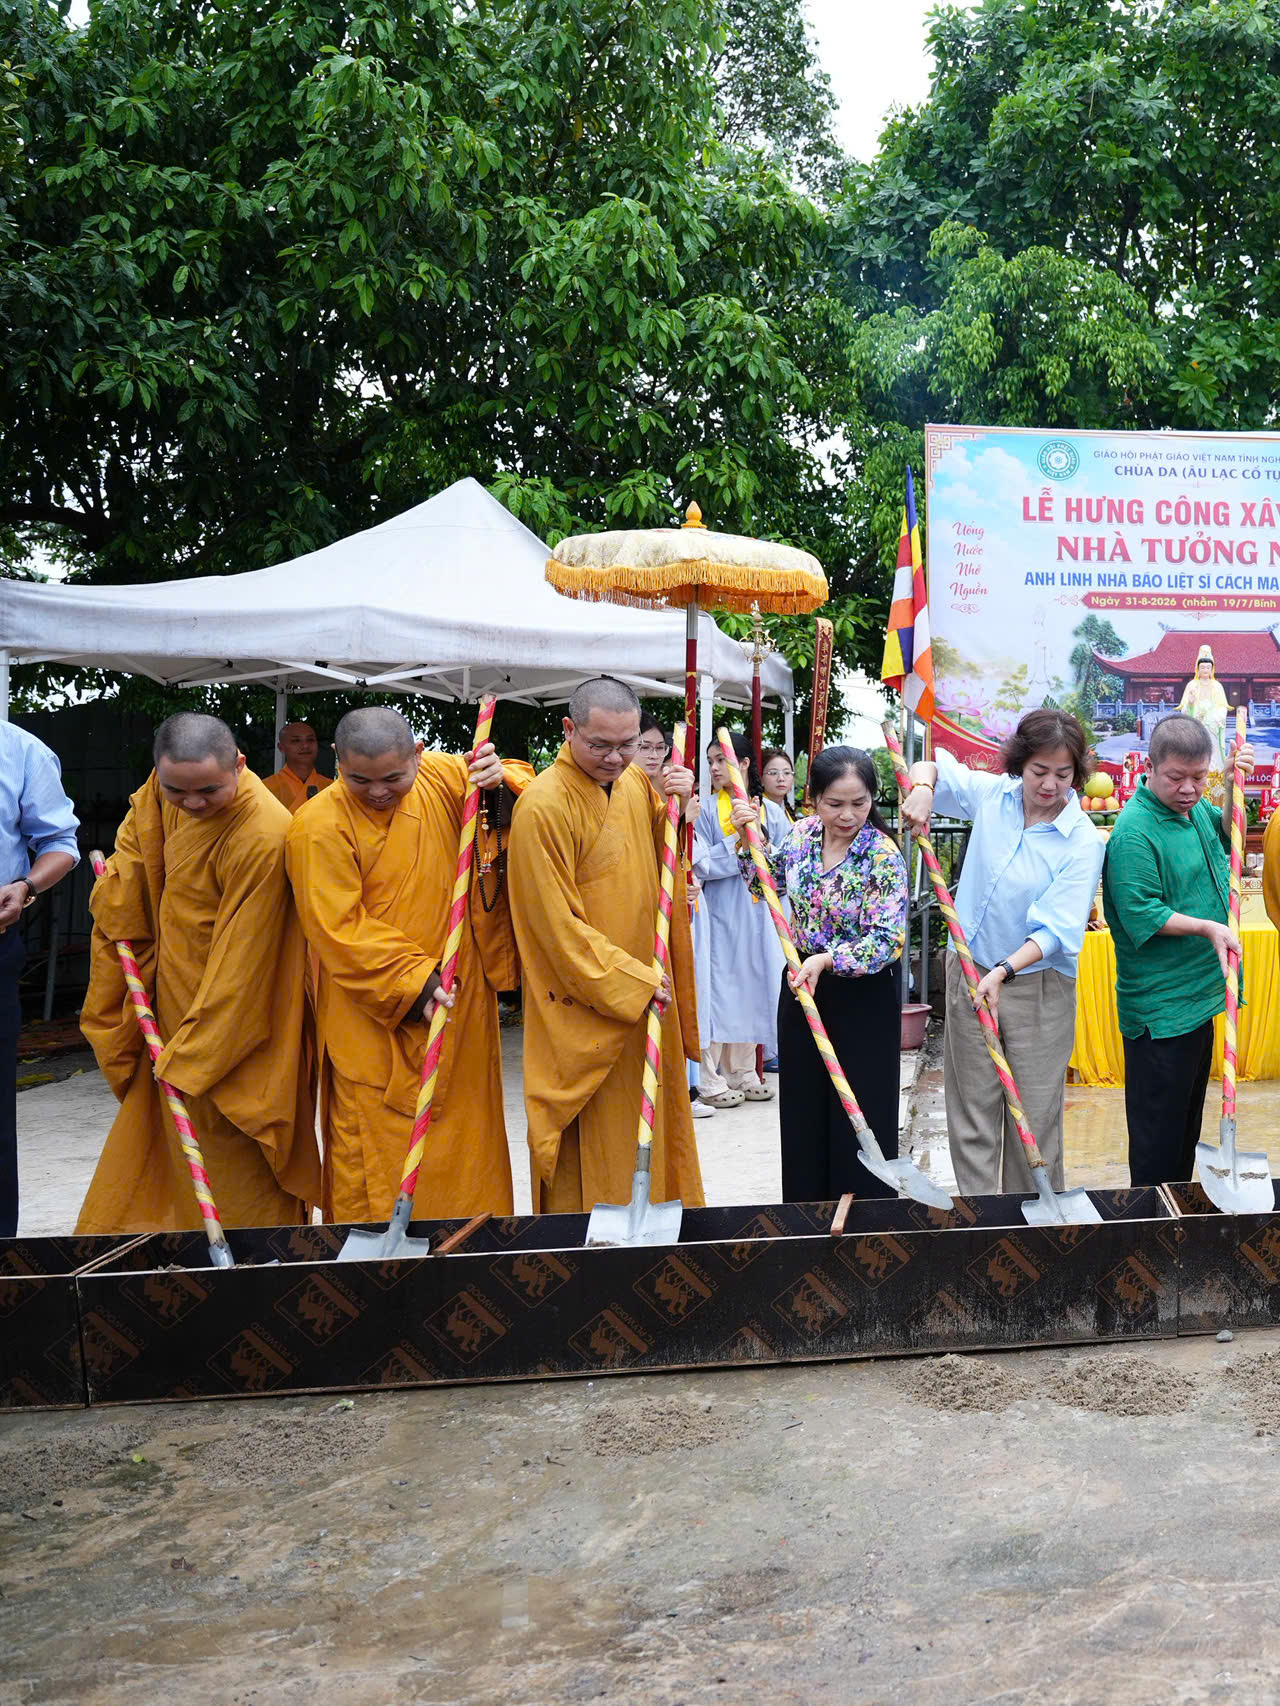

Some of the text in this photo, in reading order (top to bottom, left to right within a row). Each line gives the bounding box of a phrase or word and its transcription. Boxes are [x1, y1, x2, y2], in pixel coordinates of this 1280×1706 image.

[1114, 463, 1154, 477] CHÙA
[1158, 466, 1178, 477] DA
[1212, 468, 1238, 481] LẠC
[1214, 454, 1236, 462] NAM
[1023, 486, 1054, 522] LỄ
[1065, 495, 1144, 525] HƯNG
[1155, 495, 1230, 526] CÔNG
[1057, 531, 1133, 563] NHÀ
[1141, 530, 1259, 565] TƯỞNG
[1024, 572, 1055, 586] ANH
[1060, 572, 1092, 587] LINH
[1097, 571, 1128, 588] NHÀ
[1167, 572, 1194, 590] LIỆT
[1091, 596, 1121, 607] Ngày
[1125, 597, 1177, 607] 31-8-2026
[763, 1206, 793, 1236] LYWOOD
[673, 1246, 720, 1291] TC PLYWOOD
[467, 1284, 513, 1328] TC PLYWOOD
